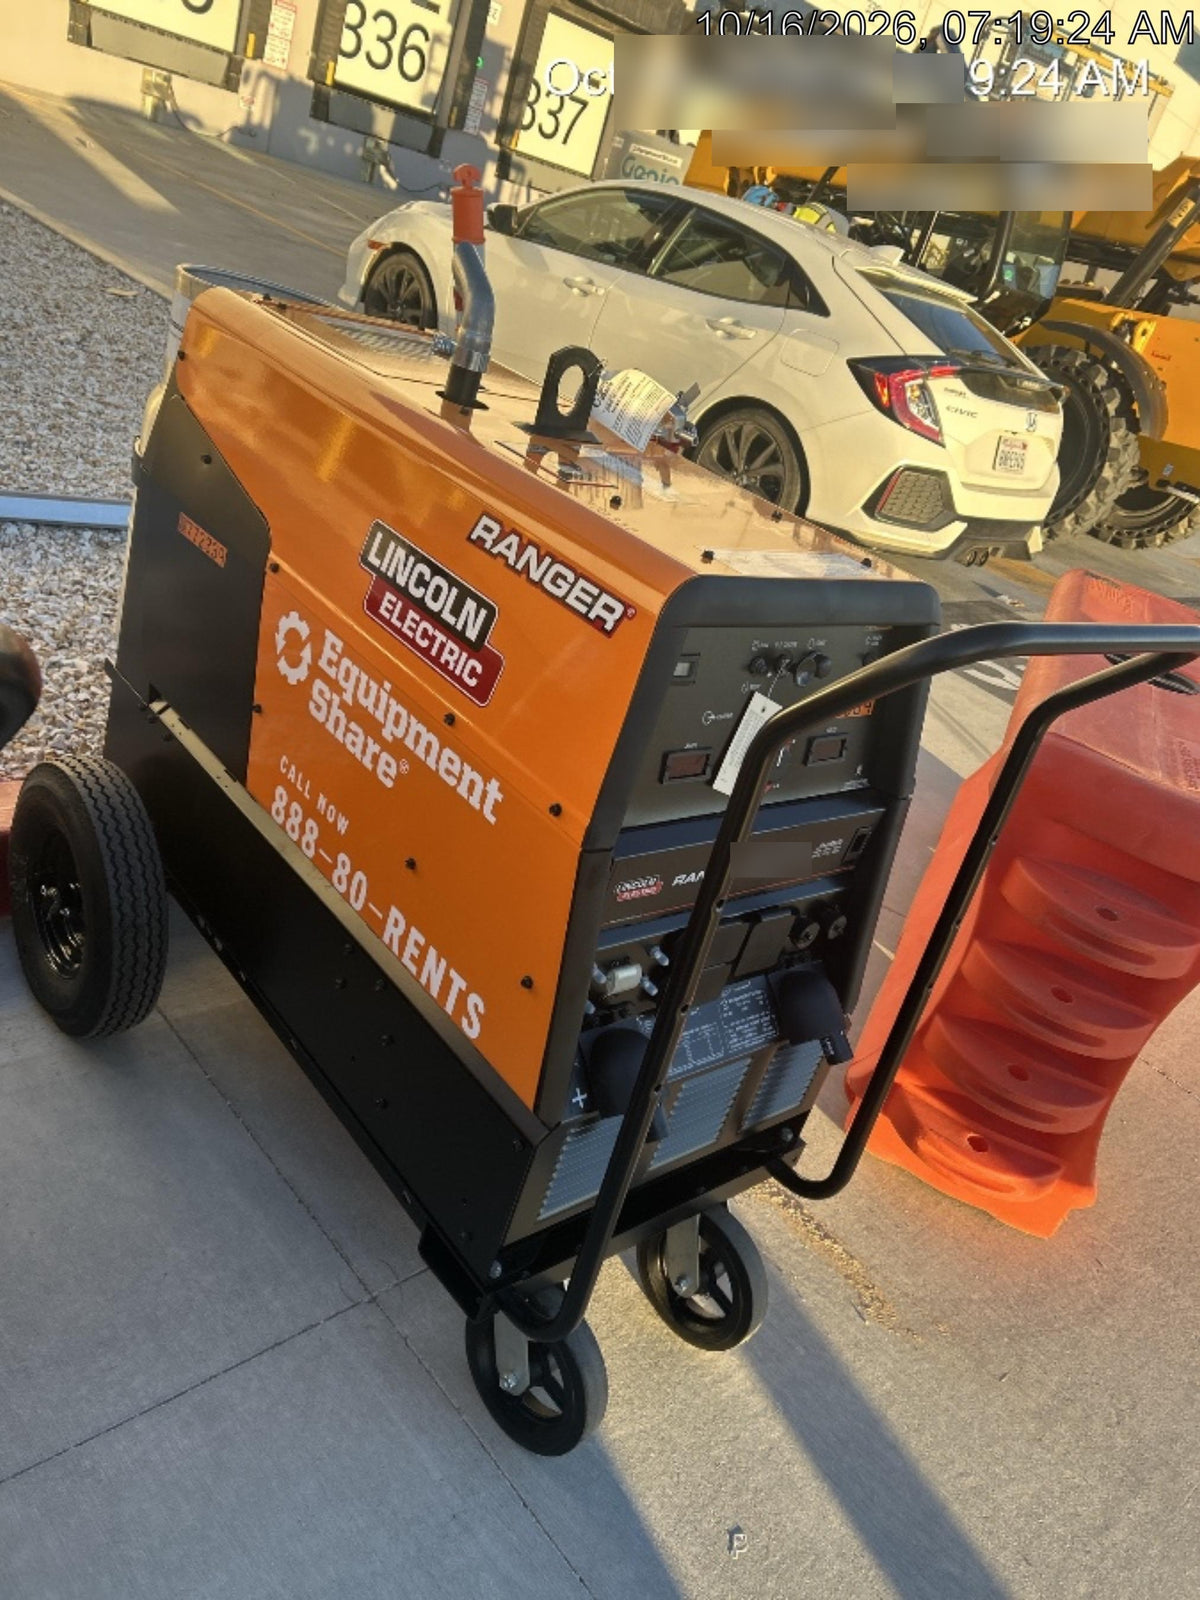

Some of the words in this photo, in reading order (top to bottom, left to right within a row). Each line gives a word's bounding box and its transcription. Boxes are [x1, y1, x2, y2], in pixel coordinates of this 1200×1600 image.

[367, 532, 487, 643] LINCOLN
[378, 591, 483, 688] ELECTRIC
[318, 629, 504, 825] Equipment
[280, 755, 311, 799] CALL
[316, 792, 349, 836] NOW
[271, 785, 485, 1039] 888-80-RENTS
